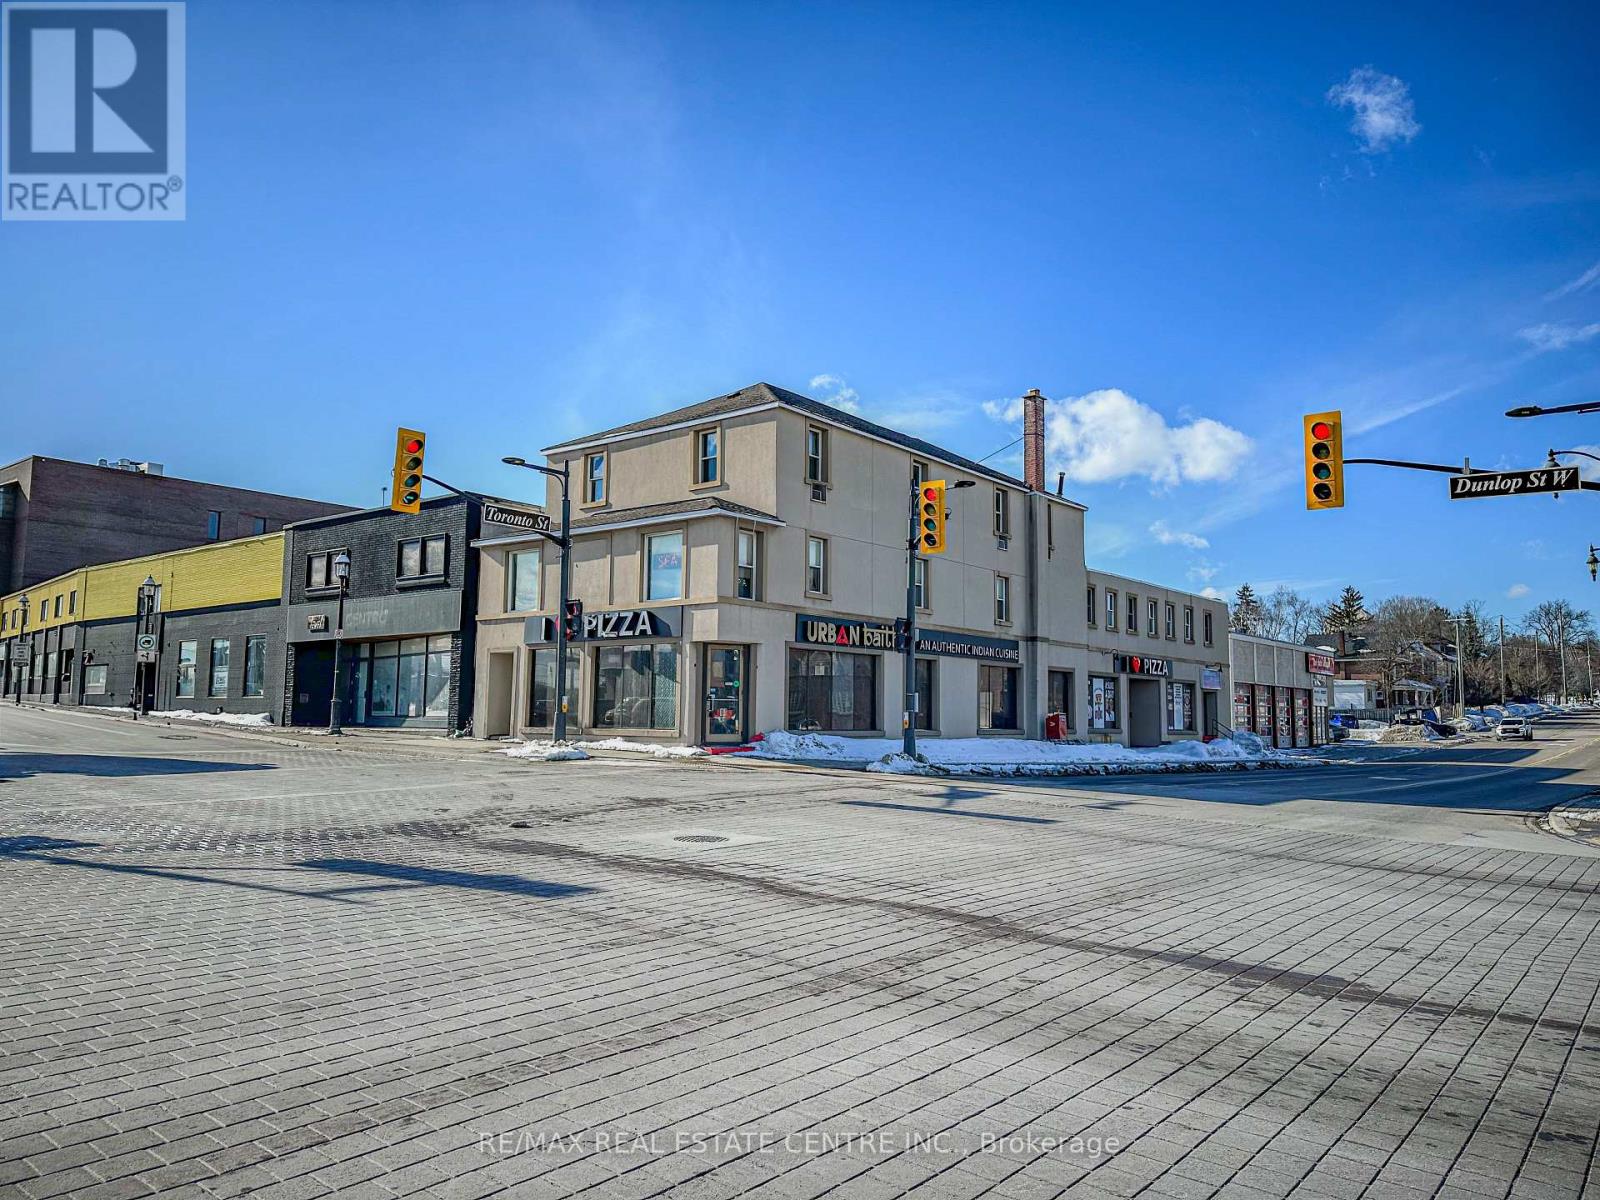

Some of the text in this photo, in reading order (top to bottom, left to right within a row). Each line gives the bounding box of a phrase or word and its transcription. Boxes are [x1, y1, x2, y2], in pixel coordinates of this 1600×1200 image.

[1454, 469, 1575, 494] Dunlop St W
[487, 506, 549, 530] Toronto St
[583, 610, 653, 638] PIZZA
[807, 620, 860, 645] URBAN
[920, 640, 1019, 660] AN AUTHENTIC INDIAN CUISINE
[1143, 658, 1169, 676] PIZZA
